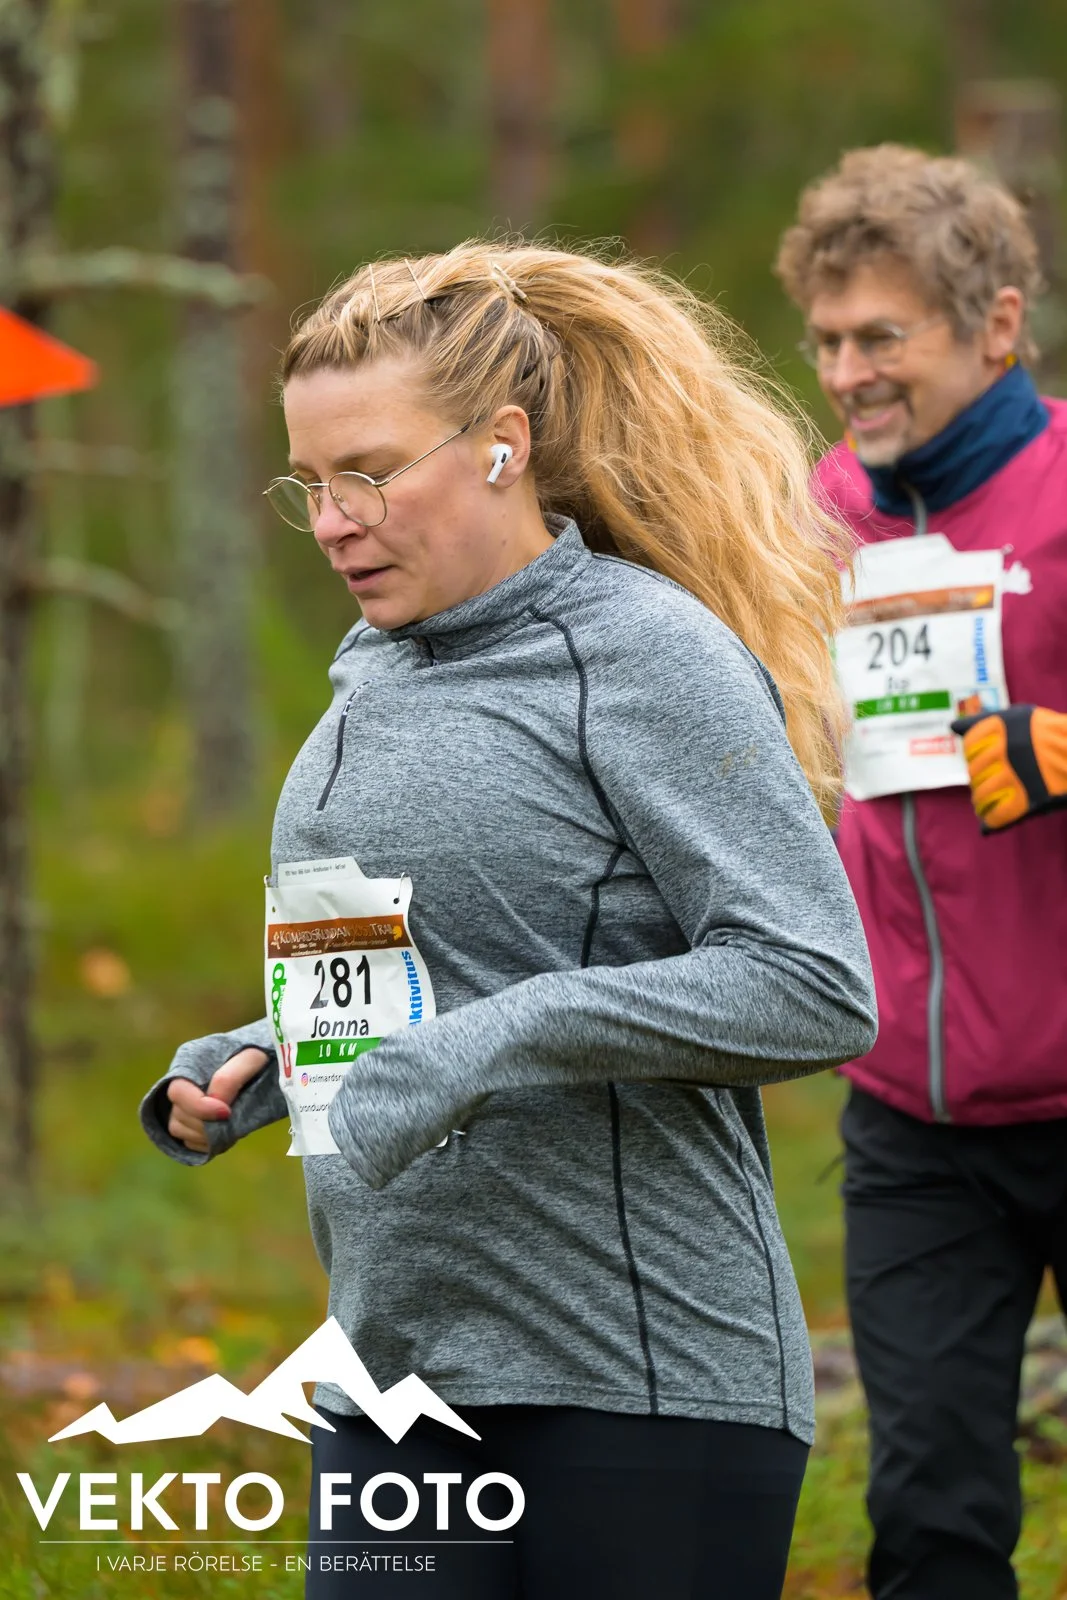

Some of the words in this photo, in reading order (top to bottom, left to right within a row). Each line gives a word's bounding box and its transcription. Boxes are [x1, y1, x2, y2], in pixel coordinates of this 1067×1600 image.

[867, 624, 931, 670] 204
[272, 963, 286, 1043] coop
[309, 954, 371, 1009] 281
[311, 1015, 369, 1038] Jonna
[318, 1043, 331, 1058] 10
[338, 1042, 358, 1057] KM
